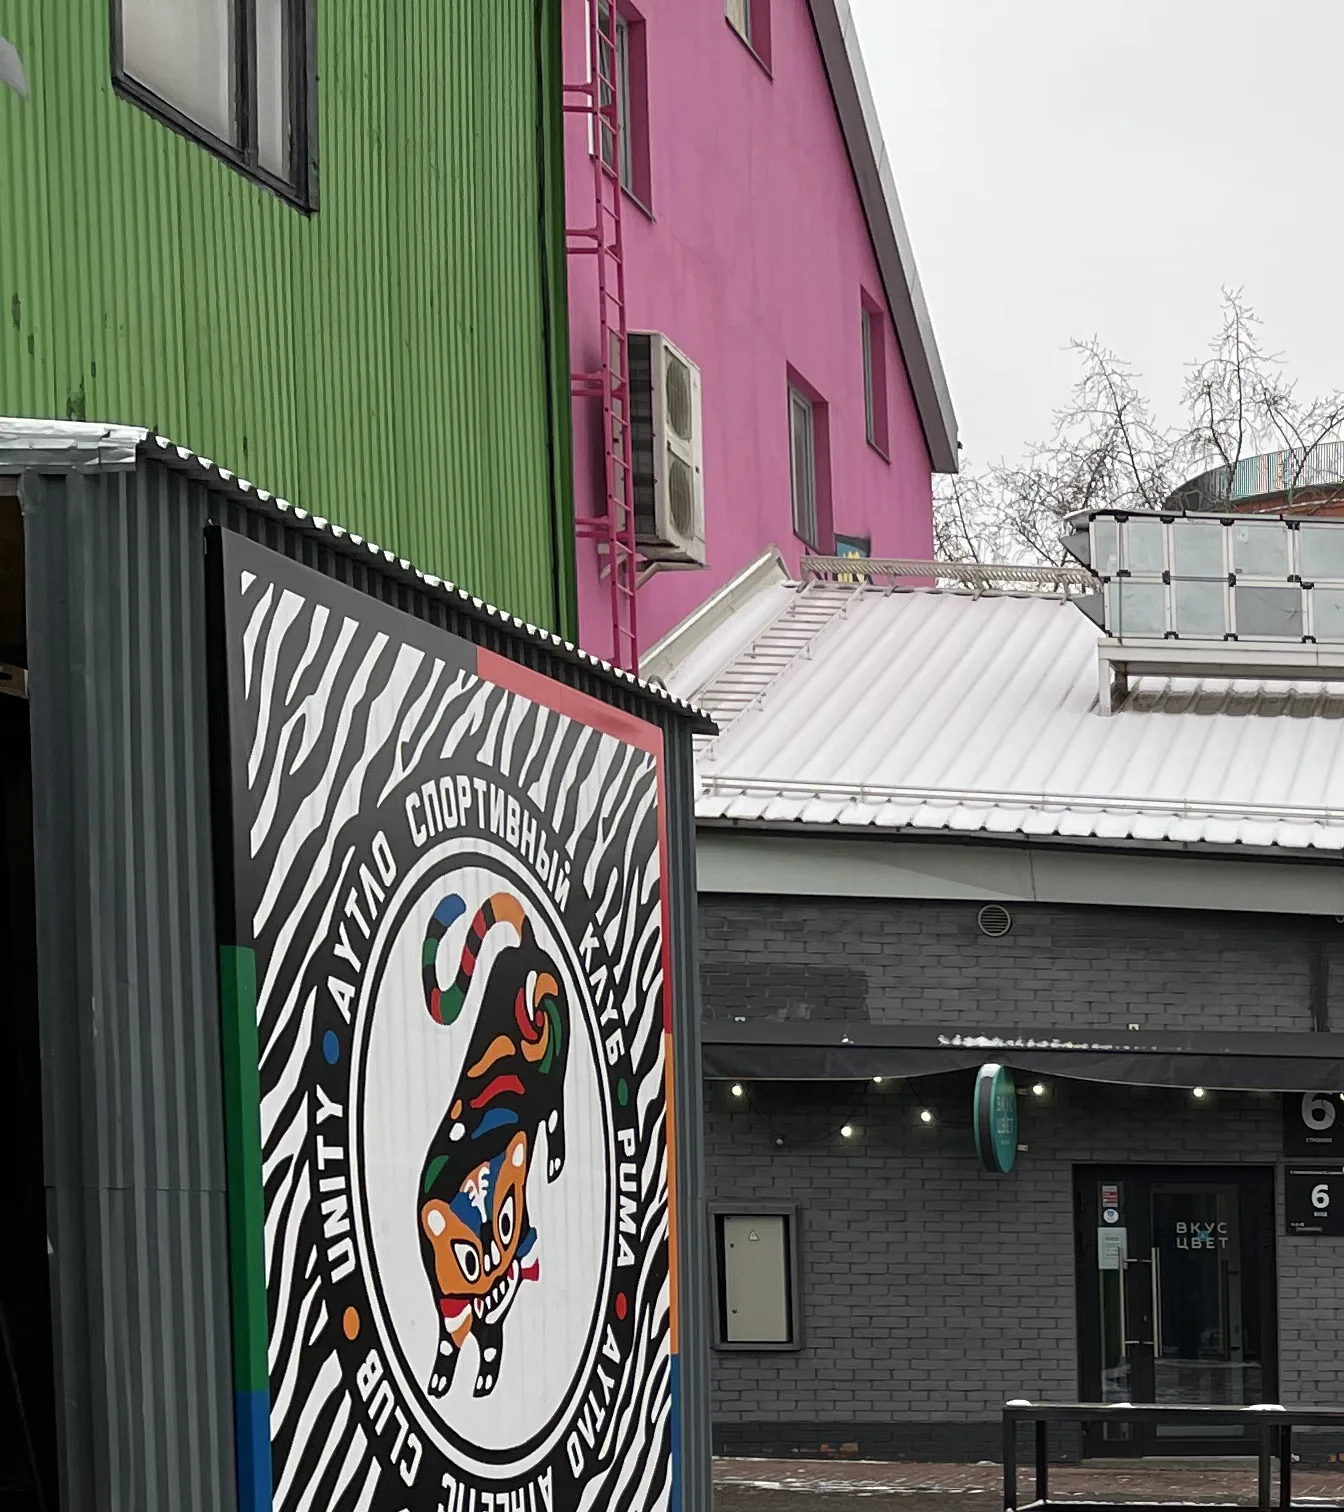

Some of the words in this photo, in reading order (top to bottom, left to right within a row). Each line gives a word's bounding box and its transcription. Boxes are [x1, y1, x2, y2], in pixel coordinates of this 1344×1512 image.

[405, 774, 571, 913] СПОРТИВНЫЙ
[579, 921, 626, 1066] КЛУБ
[1301, 1092, 1336, 1130] 6
[315, 1083, 357, 1284] UNITY
[616, 1127, 637, 1268] PUMA
[1176, 1221, 1228, 1234] ВКУС
[1311, 1184, 1330, 1209] 6
[1176, 1237, 1229, 1251] ЦВЕТ
[356, 1348, 422, 1488] CLUB
